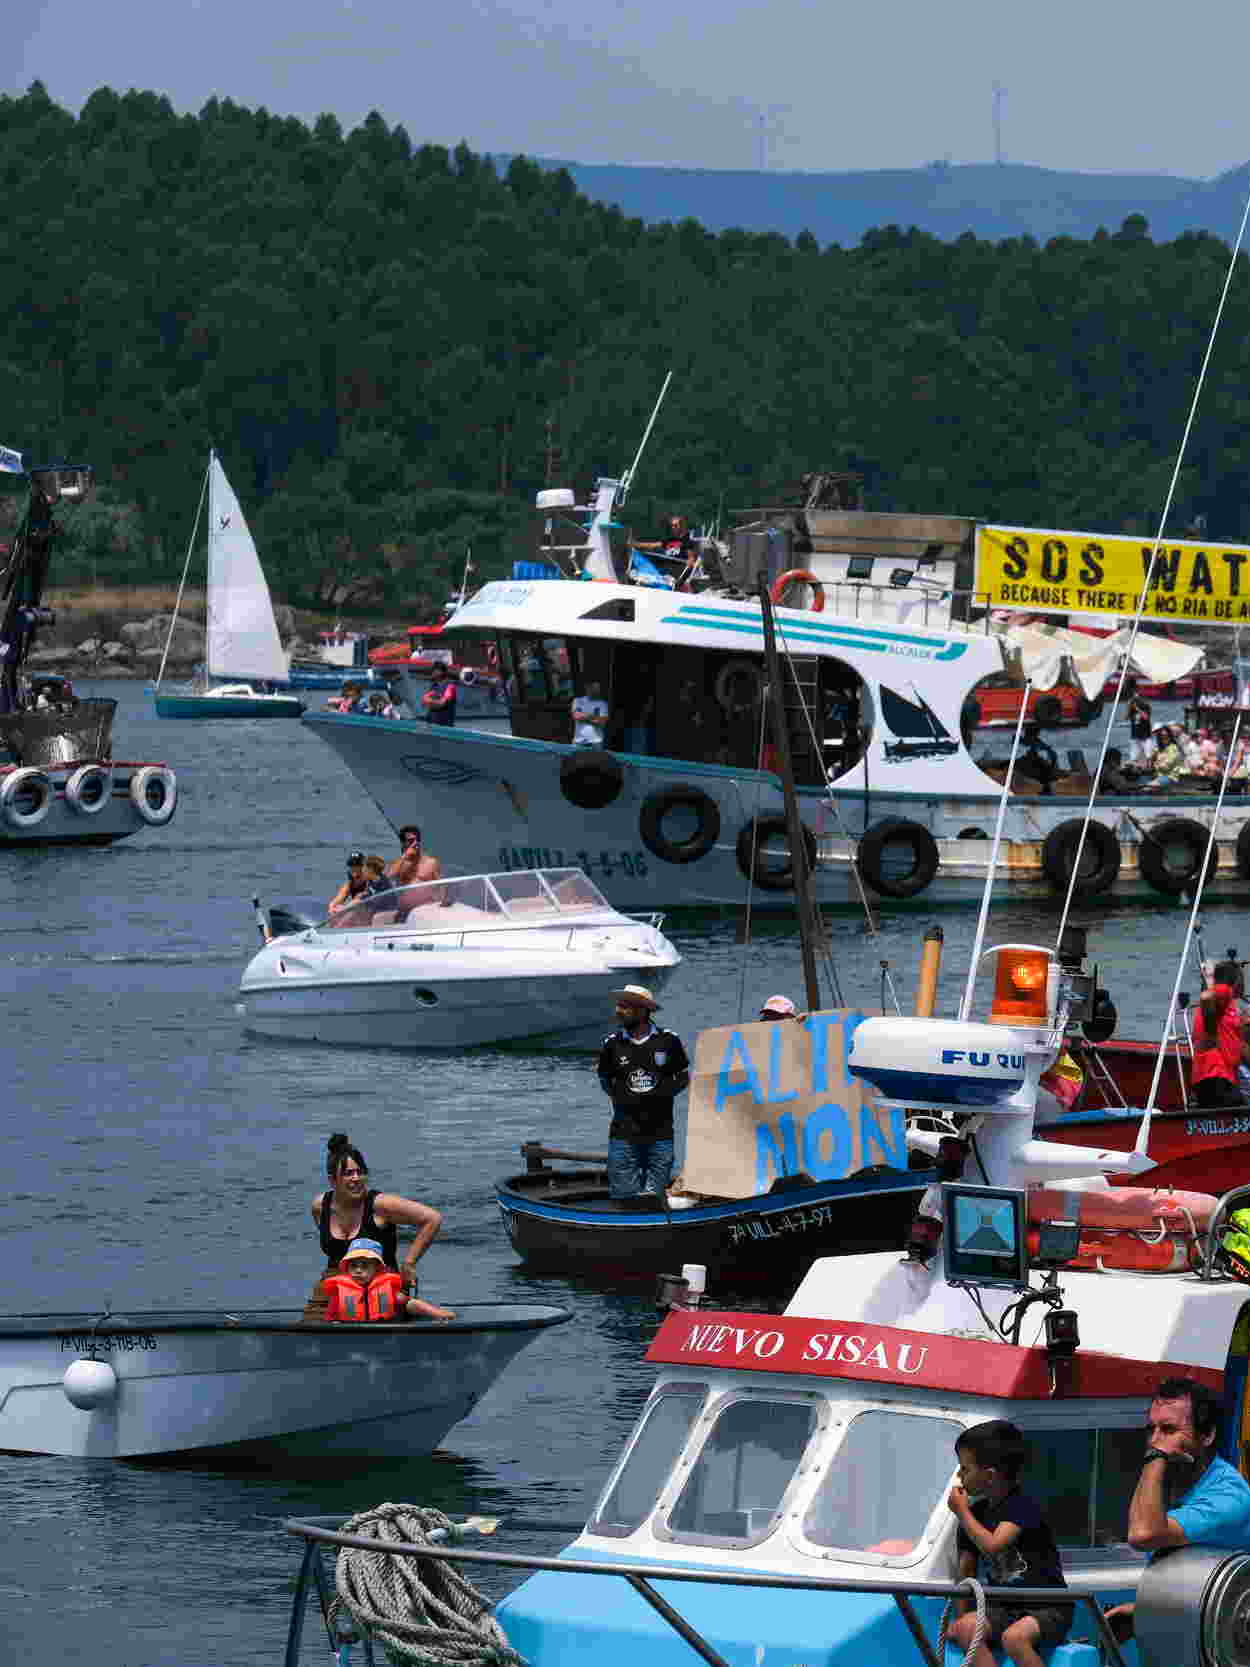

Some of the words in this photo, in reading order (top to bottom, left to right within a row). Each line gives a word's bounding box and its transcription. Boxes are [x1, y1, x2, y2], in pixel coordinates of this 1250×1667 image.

[1002, 536, 1105, 587] SOS
[1000, 584, 1071, 606] BECAUSE
[1076, 588, 1128, 610] THERE
[1133, 592, 1149, 612] IS
[1155, 596, 1178, 614] NO
[1183, 597, 1208, 617] RIA
[1215, 600, 1234, 617] DE
[680, 1324, 786, 1359] NUEVO
[801, 1332, 930, 1376] SISAU
